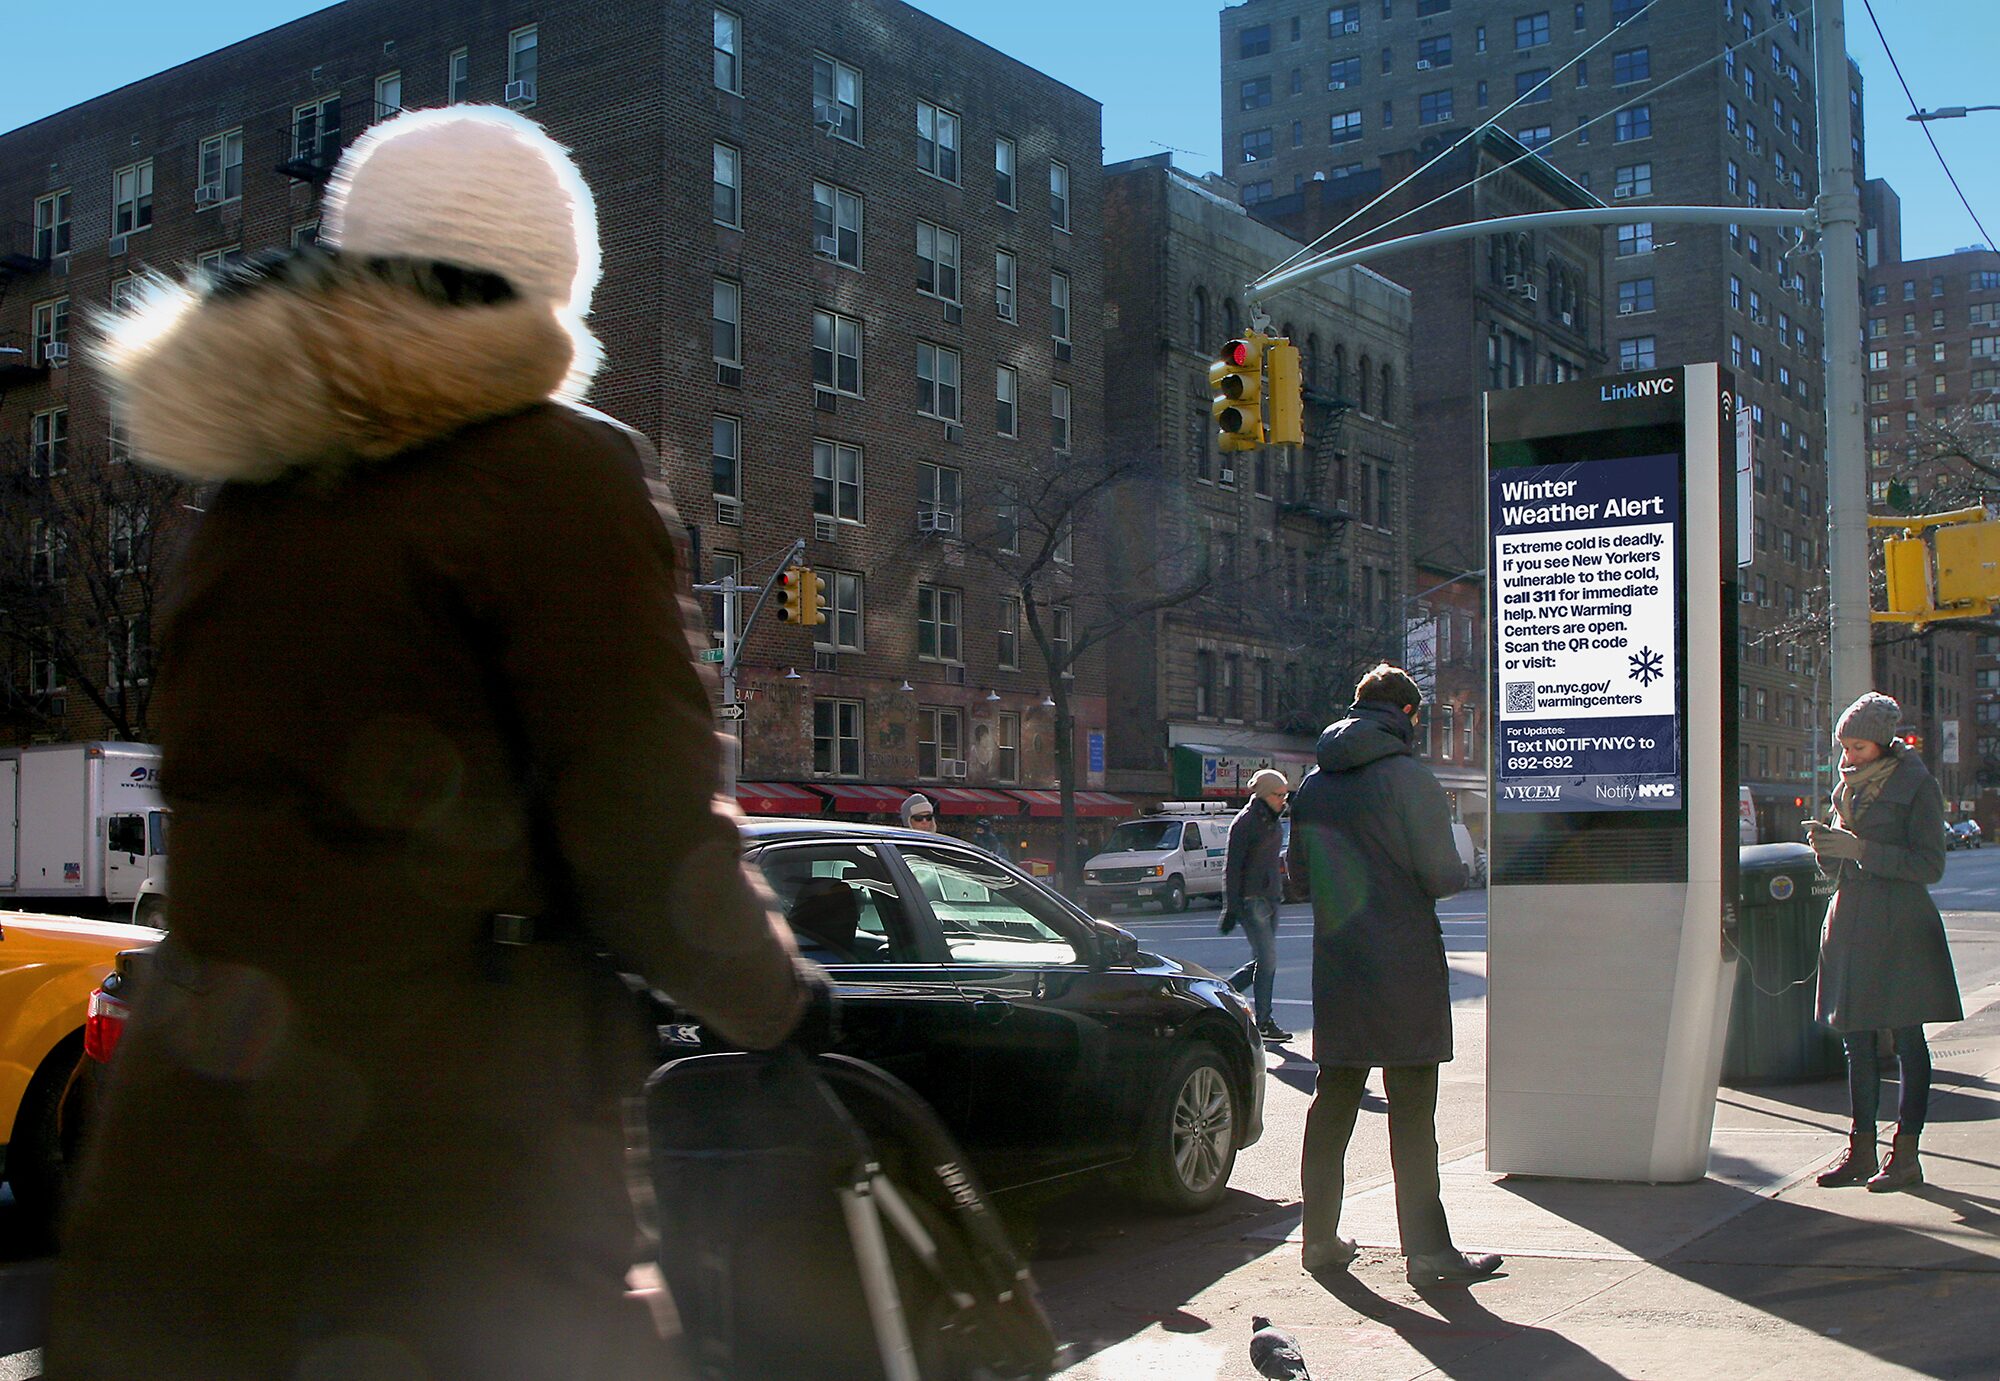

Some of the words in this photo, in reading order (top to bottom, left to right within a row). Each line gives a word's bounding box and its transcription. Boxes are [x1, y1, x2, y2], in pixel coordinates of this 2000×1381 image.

[1601, 377, 1674, 401] LinkNYC
[1501, 480, 1578, 501] Winter
[1501, 502, 1600, 526] Weather
[1603, 495, 1664, 518] Alert
[1502, 540, 1563, 555] Extreme
[1565, 536, 1596, 551] cold
[1598, 536, 1611, 548] is
[1613, 532, 1664, 547] deadly.
[1502, 559, 1514, 572] If
[1516, 559, 1542, 573] you
[1544, 556, 1570, 568] see
[1572, 555, 1603, 567] New
[1605, 551, 1661, 564] Yorkers
[1503, 572, 1576, 588] vulnerable
[1578, 572, 1594, 583] to
[1597, 568, 1622, 581] the
[1624, 566, 1659, 580] cold,
[1503, 591, 1530, 605] call
[1532, 590, 1556, 603] 311
[1558, 588, 1580, 601] for
[1582, 583, 1659, 599] immediate
[1504, 608, 1537, 622] help.
[1539, 605, 1568, 619] NYC
[1570, 603, 1632, 617] Warming
[1504, 623, 1561, 637] Centers
[1562, 622, 1586, 634] are
[1587, 620, 1628, 635] open.
[1504, 640, 1540, 653] Scan
[1542, 639, 1566, 651] the
[1568, 638, 1589, 652] QR
[1591, 636, 1628, 649] code
[707, 650, 715, 661] 17
[1505, 658, 1520, 670] or
[1522, 656, 1556, 668] visit:
[735, 688, 741, 699] 3
[744, 690, 755, 700] AV
[1537, 679, 1611, 695] on.nyc.gov/
[1537, 694, 1643, 708] warmingcenters
[1507, 728, 1523, 736] For
[1523, 726, 1566, 738] Updates:
[1507, 739, 1543, 752] Text
[1545, 736, 1636, 752] NOTIFYNYC
[1638, 737, 1655, 749] to
[1507, 755, 1574, 770] 692-692
[1503, 785, 1562, 799] NYCEM
